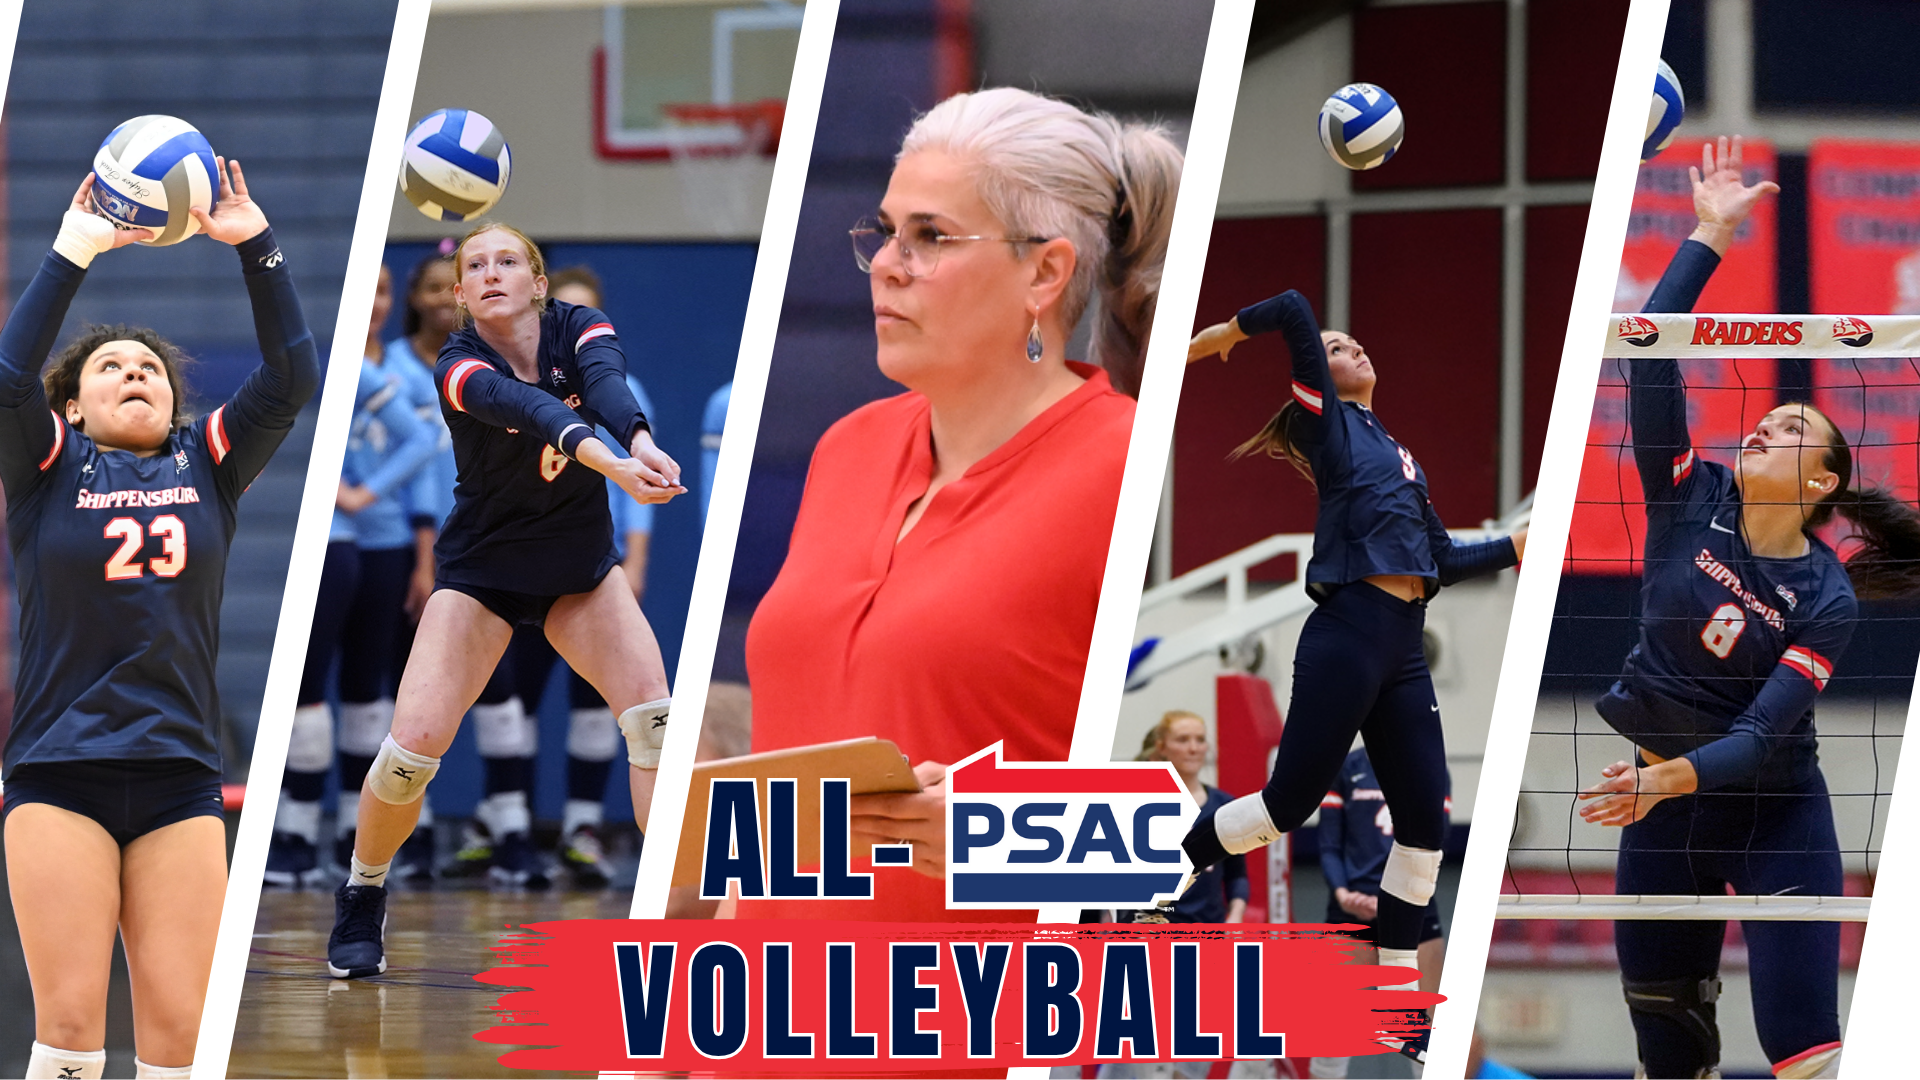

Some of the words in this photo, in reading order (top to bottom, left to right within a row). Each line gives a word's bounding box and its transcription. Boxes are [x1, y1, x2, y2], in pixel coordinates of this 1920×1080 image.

[121, 178, 150, 199] Super
[1690, 317, 1804, 346] RAIDERS
[103, 513, 188, 581] 23
[1700, 602, 1747, 659] 8
